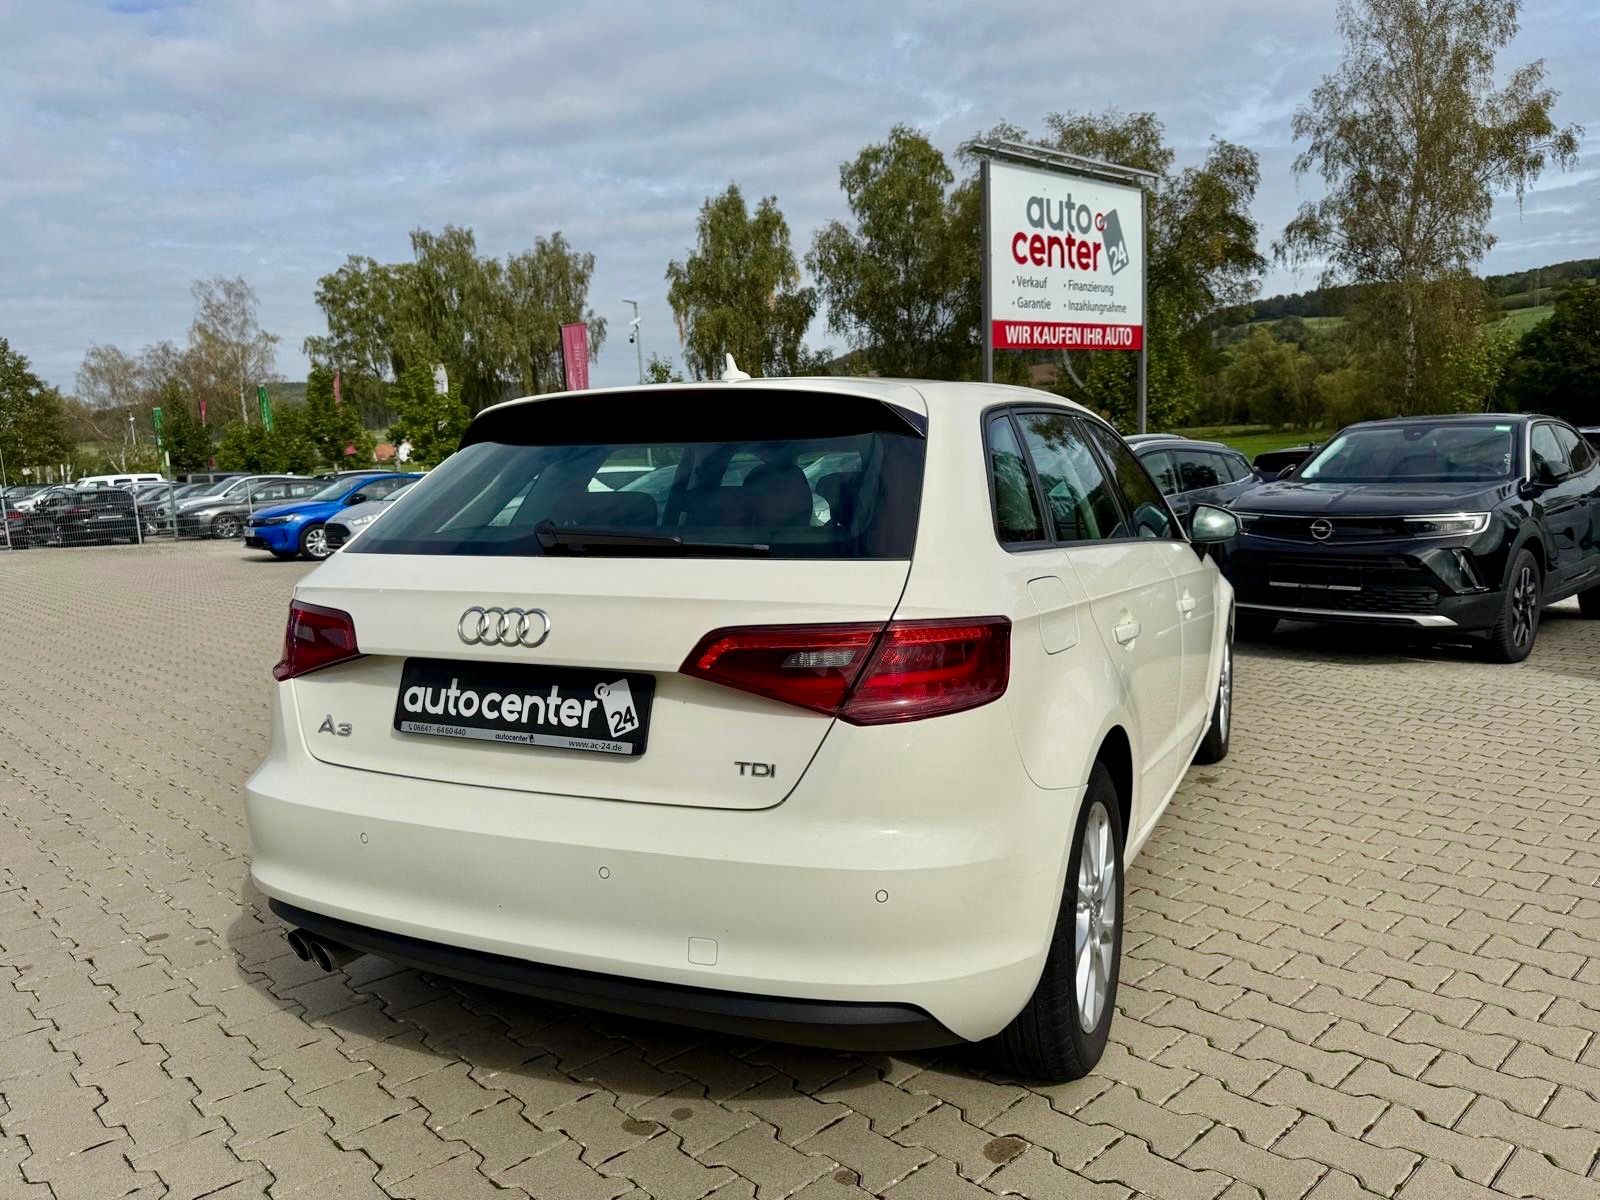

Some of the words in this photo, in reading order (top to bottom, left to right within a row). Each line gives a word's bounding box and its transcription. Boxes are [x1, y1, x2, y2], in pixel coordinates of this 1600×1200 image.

[1026, 193, 1092, 235] auto
[1011, 231, 1102, 272] center
[1109, 240, 1127, 269] 24
[1016, 275, 1048, 289] Verkauf
[1068, 280, 1114, 296] Finanzierung
[1017, 296, 1051, 310] Garantie
[1068, 300, 1127, 315] Inzahlungnahme
[1005, 324, 1031, 344] WIR
[1033, 326, 1081, 345] KAUFEN
[1083, 327, 1103, 345] IHR
[1104, 328, 1133, 346] AUTO
[403, 677, 597, 729] autocenter
[318, 714, 352, 737] A3
[609, 704, 636, 734] 24
[495, 733, 528, 742] autocenter
[568, 740, 623, 752] www.ac-24.de
[734, 761, 775, 778] TDI
